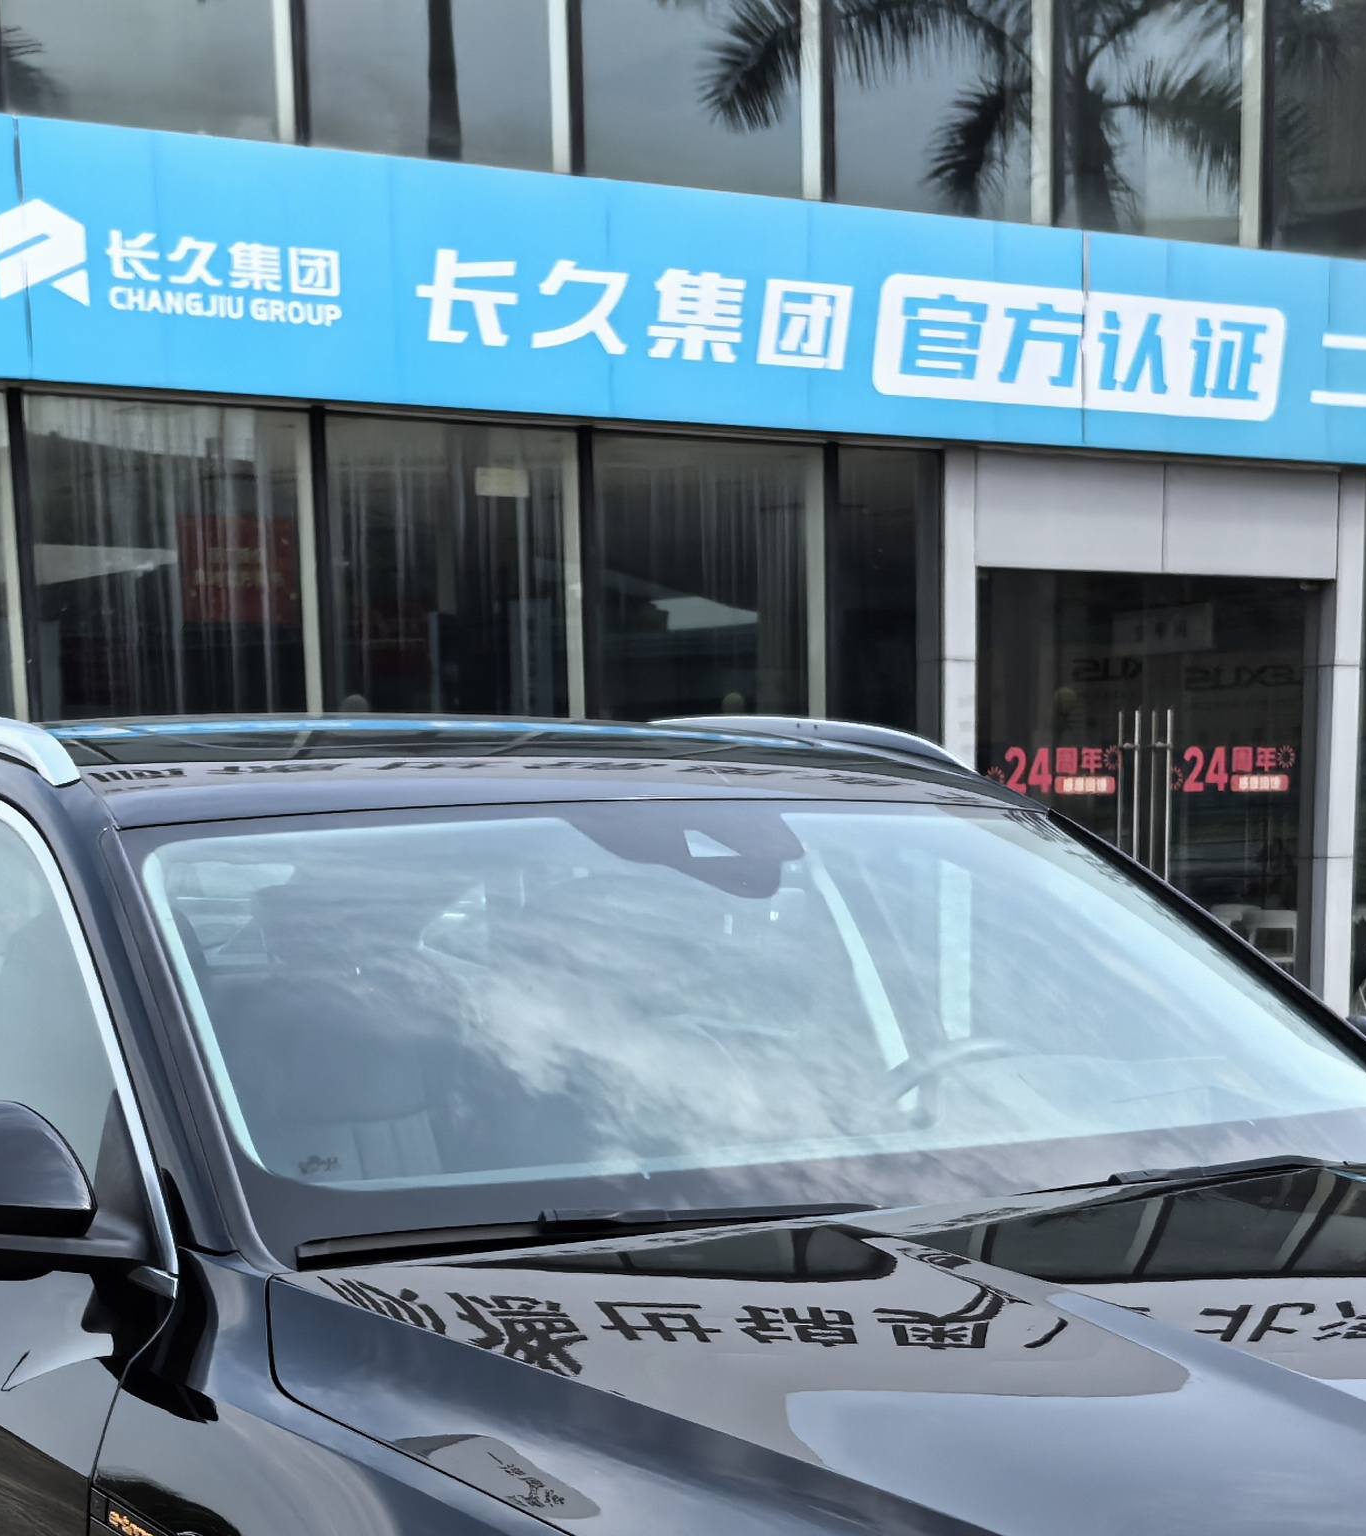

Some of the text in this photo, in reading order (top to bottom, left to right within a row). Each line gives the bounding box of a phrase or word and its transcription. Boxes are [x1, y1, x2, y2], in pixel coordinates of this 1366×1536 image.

[105, 228, 341, 298] 长久集团
[108, 286, 343, 327] CHANGJIU GROUP
[415, 249, 853, 371] 长久集团
[899, 294, 1269, 401] 官方认证
